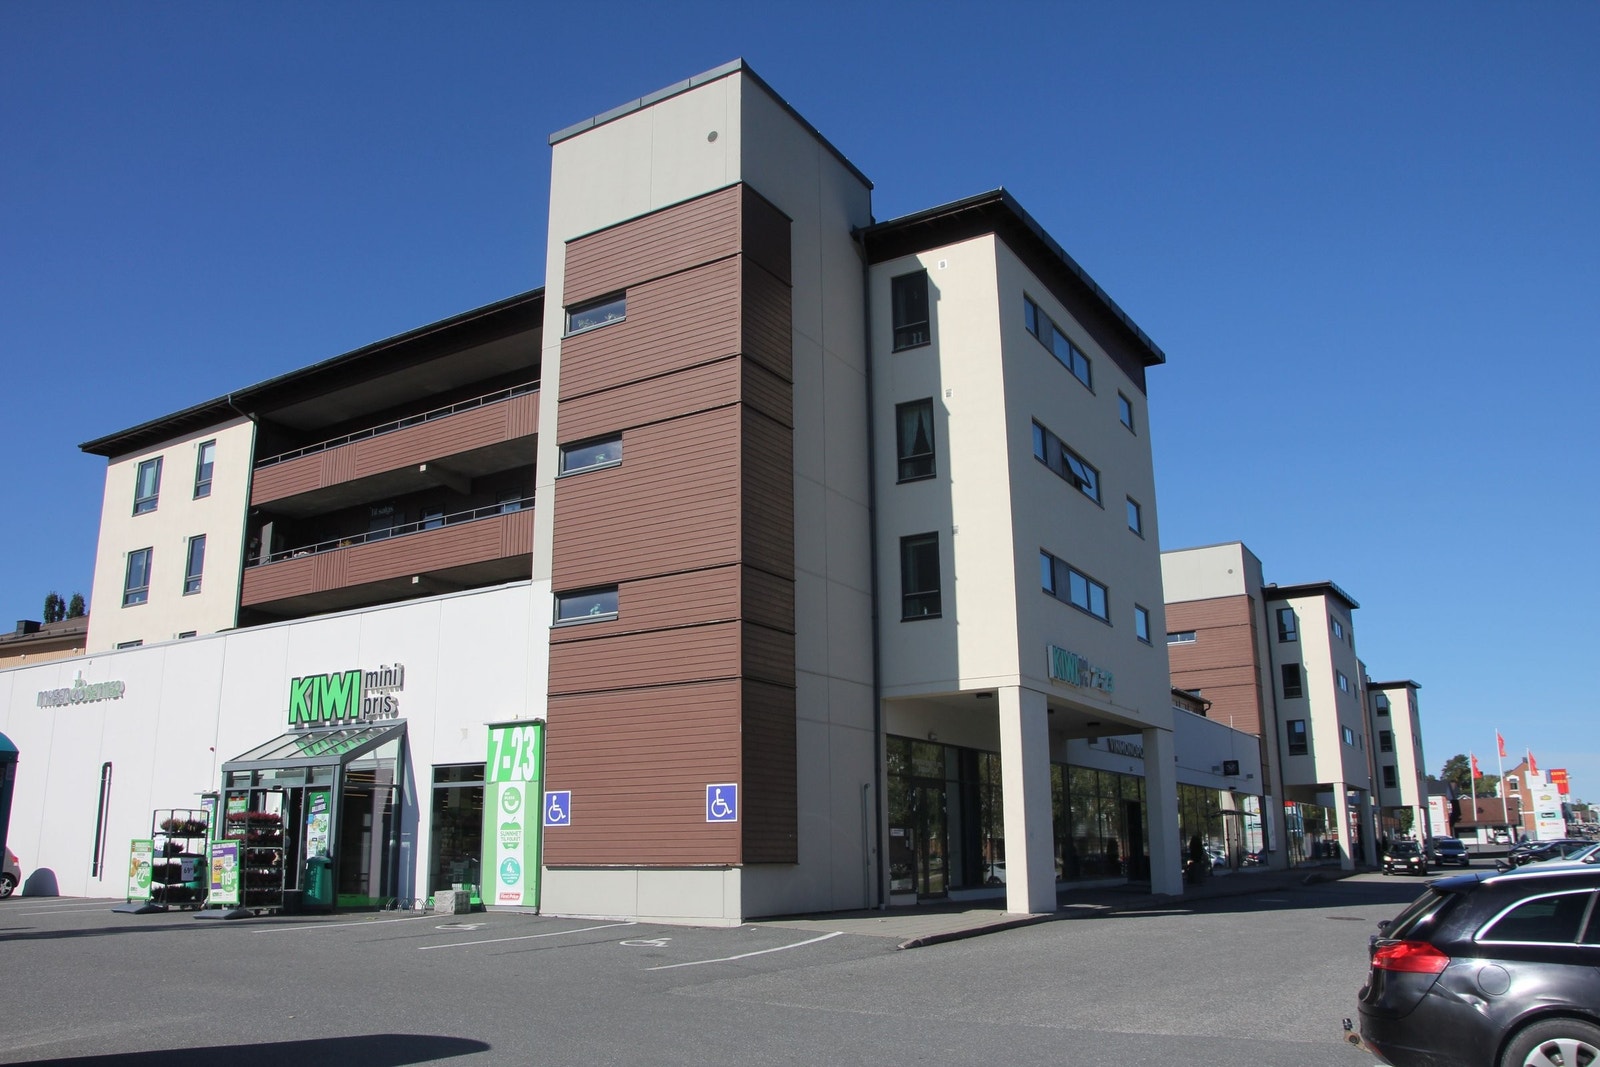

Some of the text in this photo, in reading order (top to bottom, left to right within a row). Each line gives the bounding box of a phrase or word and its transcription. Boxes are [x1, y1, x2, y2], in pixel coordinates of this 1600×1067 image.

[1049, 645, 1081, 687] KIWI
[288, 662, 400, 725] KIWI mini
[363, 690, 393, 719] pris
[491, 726, 535, 782] 7-23
